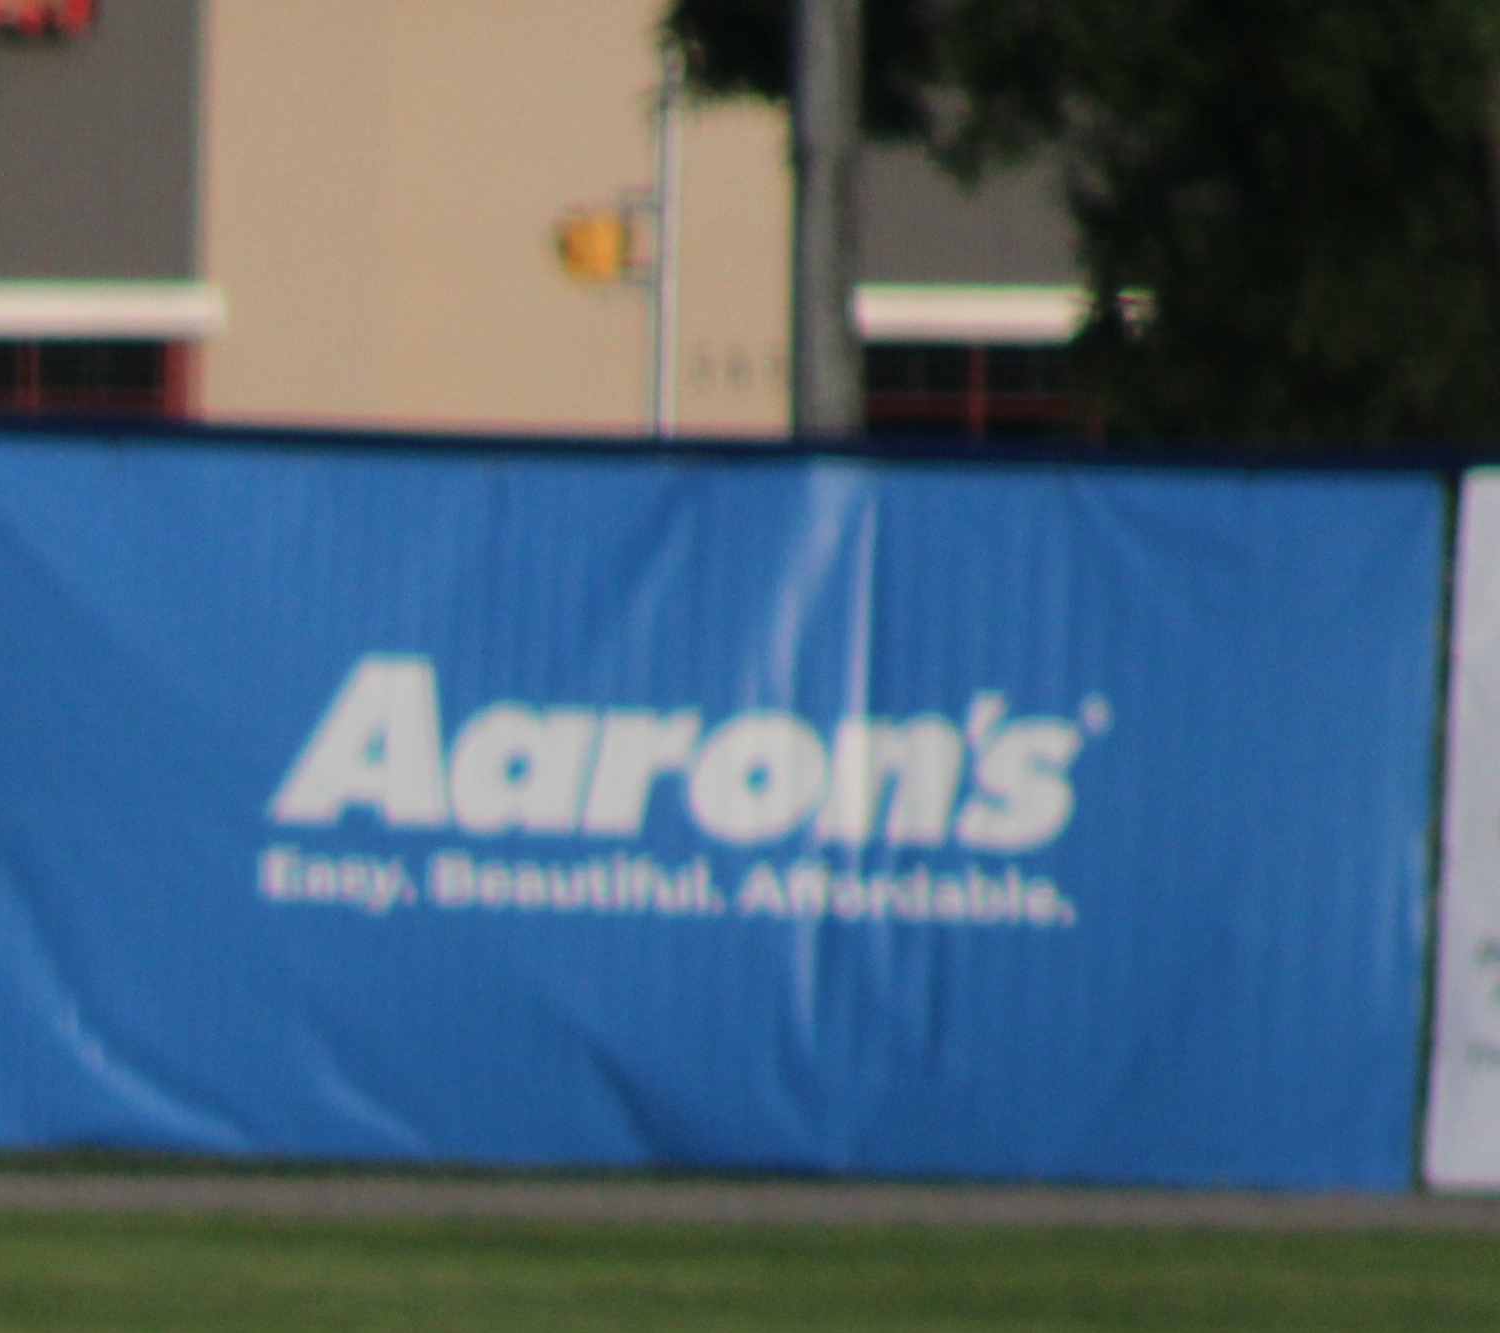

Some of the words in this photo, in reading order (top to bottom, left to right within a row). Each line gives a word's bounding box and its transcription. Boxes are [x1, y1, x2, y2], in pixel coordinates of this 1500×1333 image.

[268, 651, 1083, 853] Aaron's
[260, 848, 417, 914] Easy.
[429, 853, 726, 914] Beautiful.
